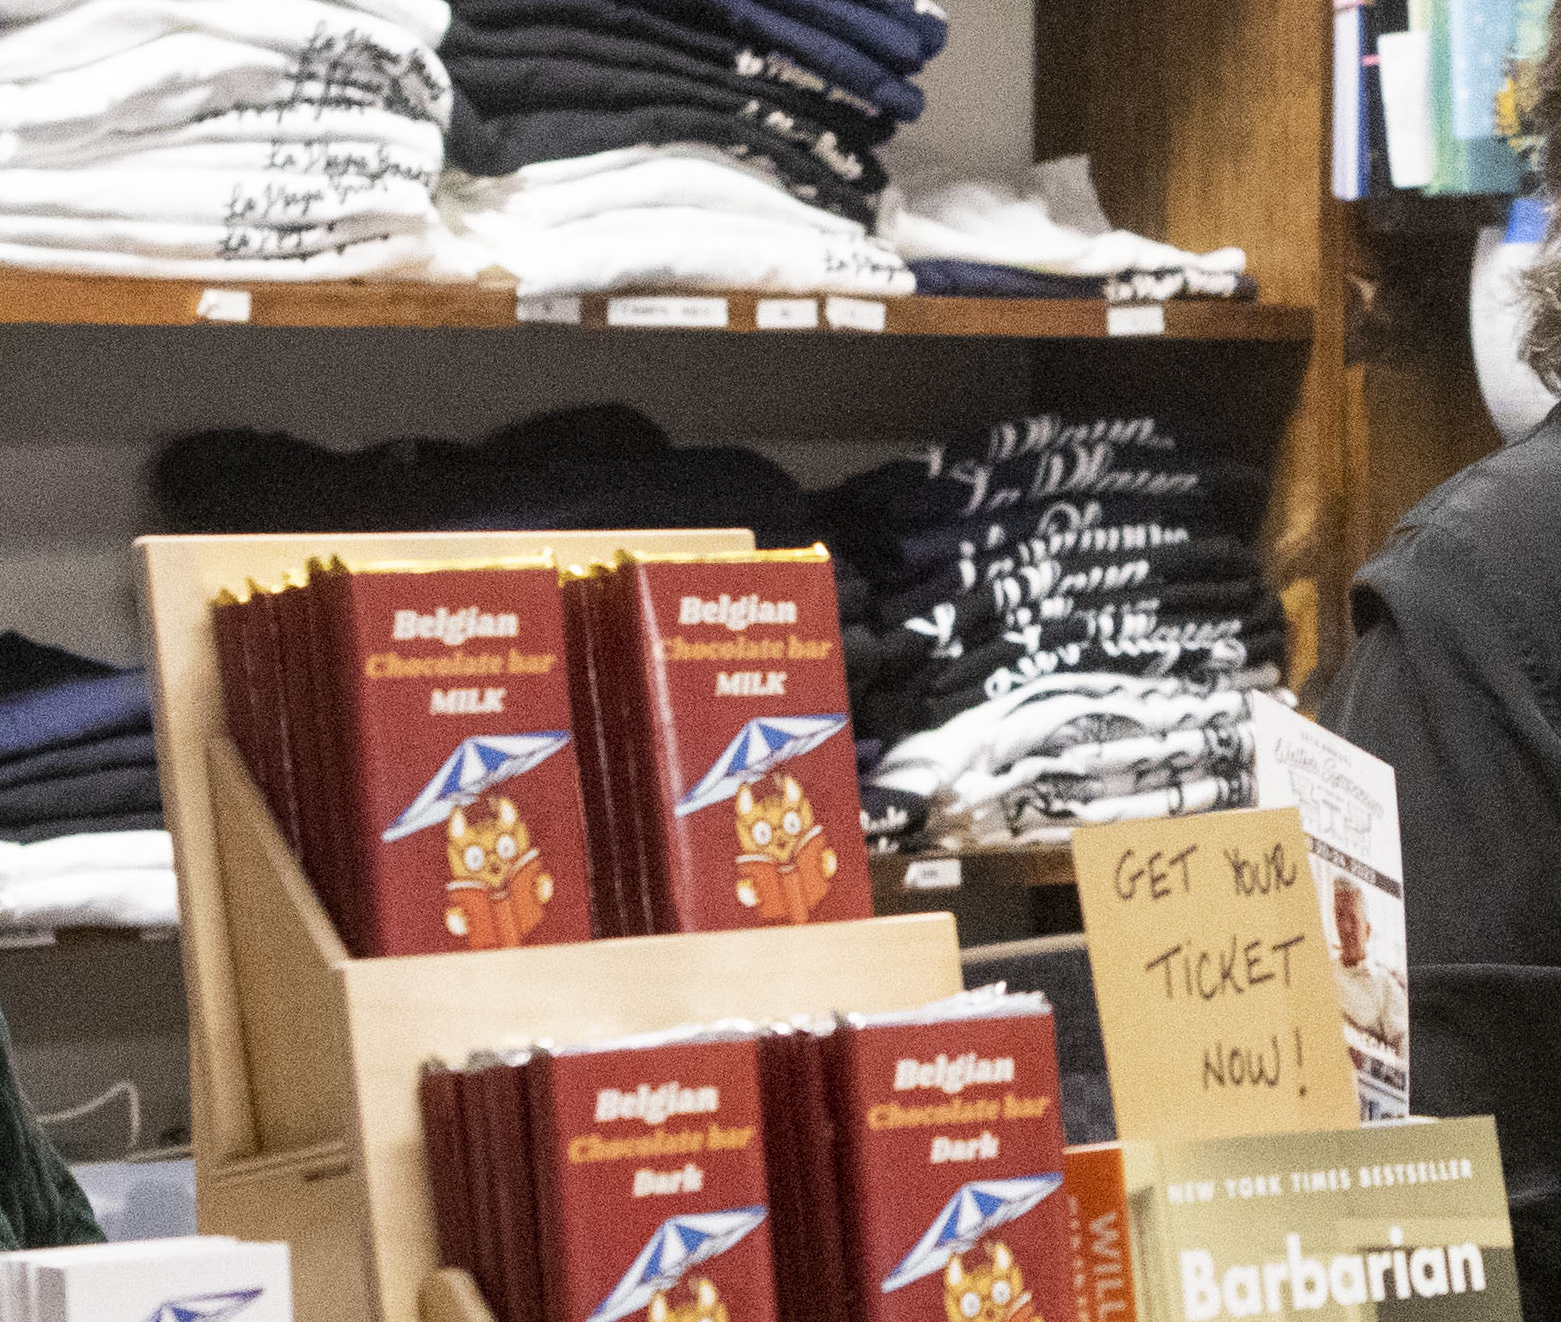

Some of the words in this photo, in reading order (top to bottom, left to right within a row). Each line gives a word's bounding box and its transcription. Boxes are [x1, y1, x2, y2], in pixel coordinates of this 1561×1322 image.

[393, 608, 518, 648] Belgian
[678, 594, 797, 630] Belgian
[365, 650, 514, 679] Chocolate
[520, 649, 557, 675] bar
[663, 636, 785, 661] Chocolate
[789, 636, 832, 661] bar
[429, 687, 505, 715] MILK
[716, 671, 786, 697] MILK
[1114, 844, 1199, 902] GET
[1223, 842, 1299, 898] YOUR
[1145, 935, 1305, 1001] TICKET
[895, 1053, 1014, 1094] Belgian
[1201, 1026, 1309, 1098] NOW!
[595, 1082, 719, 1125] Belgian
[868, 1097, 999, 1131] Chocolate
[1006, 1093, 1050, 1117] bar
[568, 1129, 705, 1164] Chocolate
[709, 1125, 753, 1150] bar
[931, 1132, 999, 1164] Dark
[633, 1165, 703, 1197] Dark
[1168, 1175, 1215, 1204] NEW
[1223, 1169, 1282, 1200] YORK
[1289, 1164, 1351, 1195] TIMES
[1358, 1158, 1474, 1190] BESTSELLER
[1180, 1228, 1487, 1322] Barbarian
